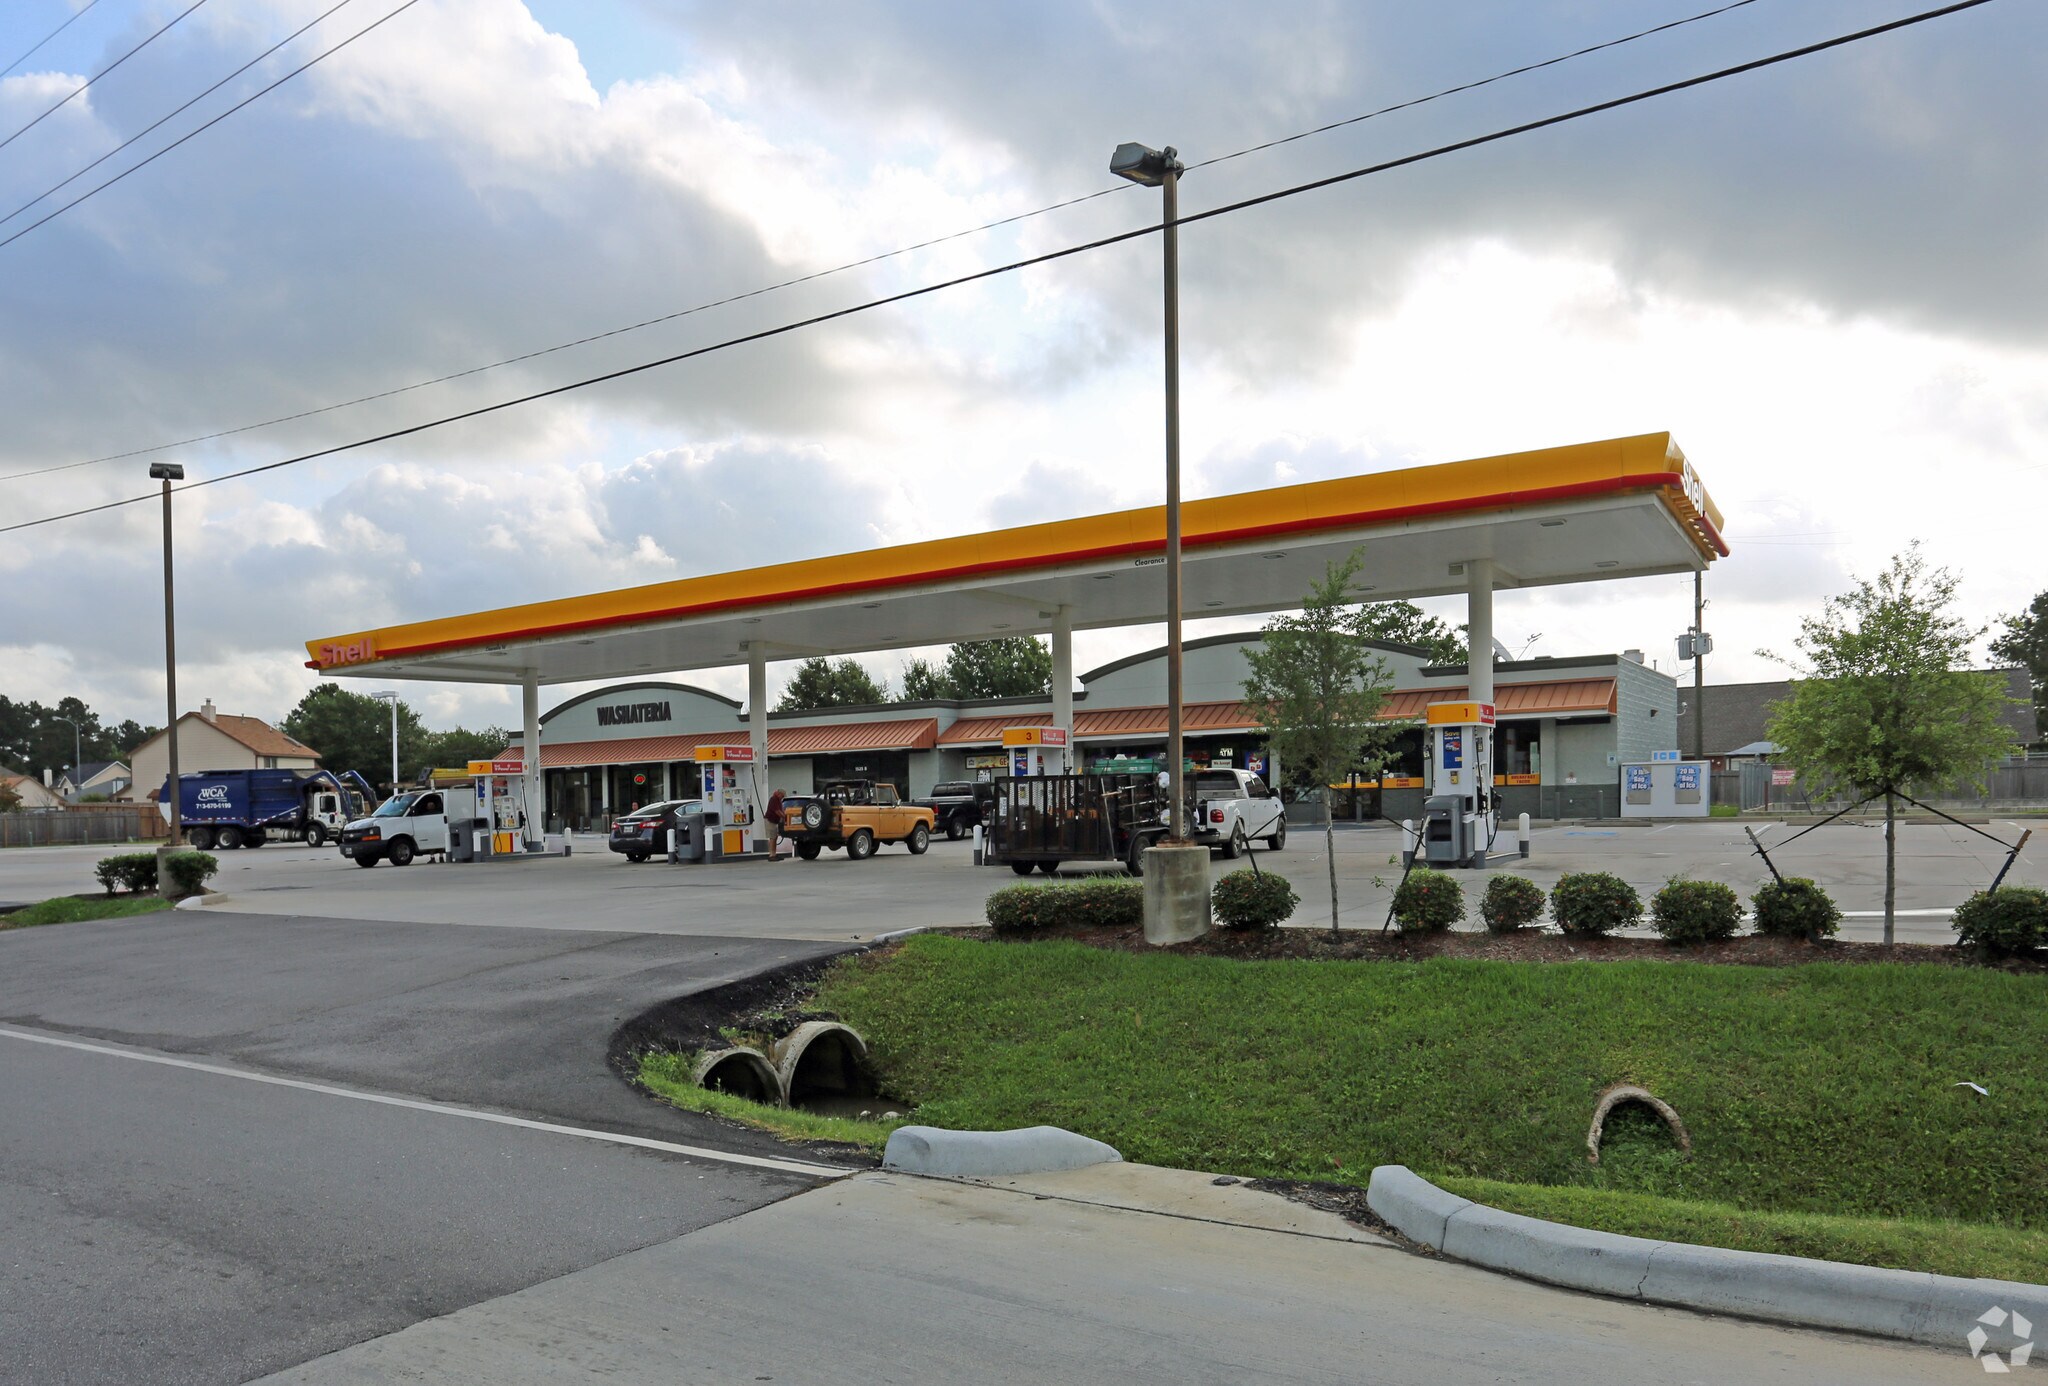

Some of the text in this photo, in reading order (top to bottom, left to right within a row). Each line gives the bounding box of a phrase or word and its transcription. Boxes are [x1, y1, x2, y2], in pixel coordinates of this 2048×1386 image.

[1683, 458, 1704, 518] Shell
[1135, 557, 1165, 567] Clearance
[320, 638, 371, 666] Shell
[597, 701, 671, 726] WASHATERIA
[1464, 708, 1468, 717] 1
[1026, 732, 1032, 741] 3
[1654, 752, 1677, 760] ICE
[201, 788, 224, 798] WCA
